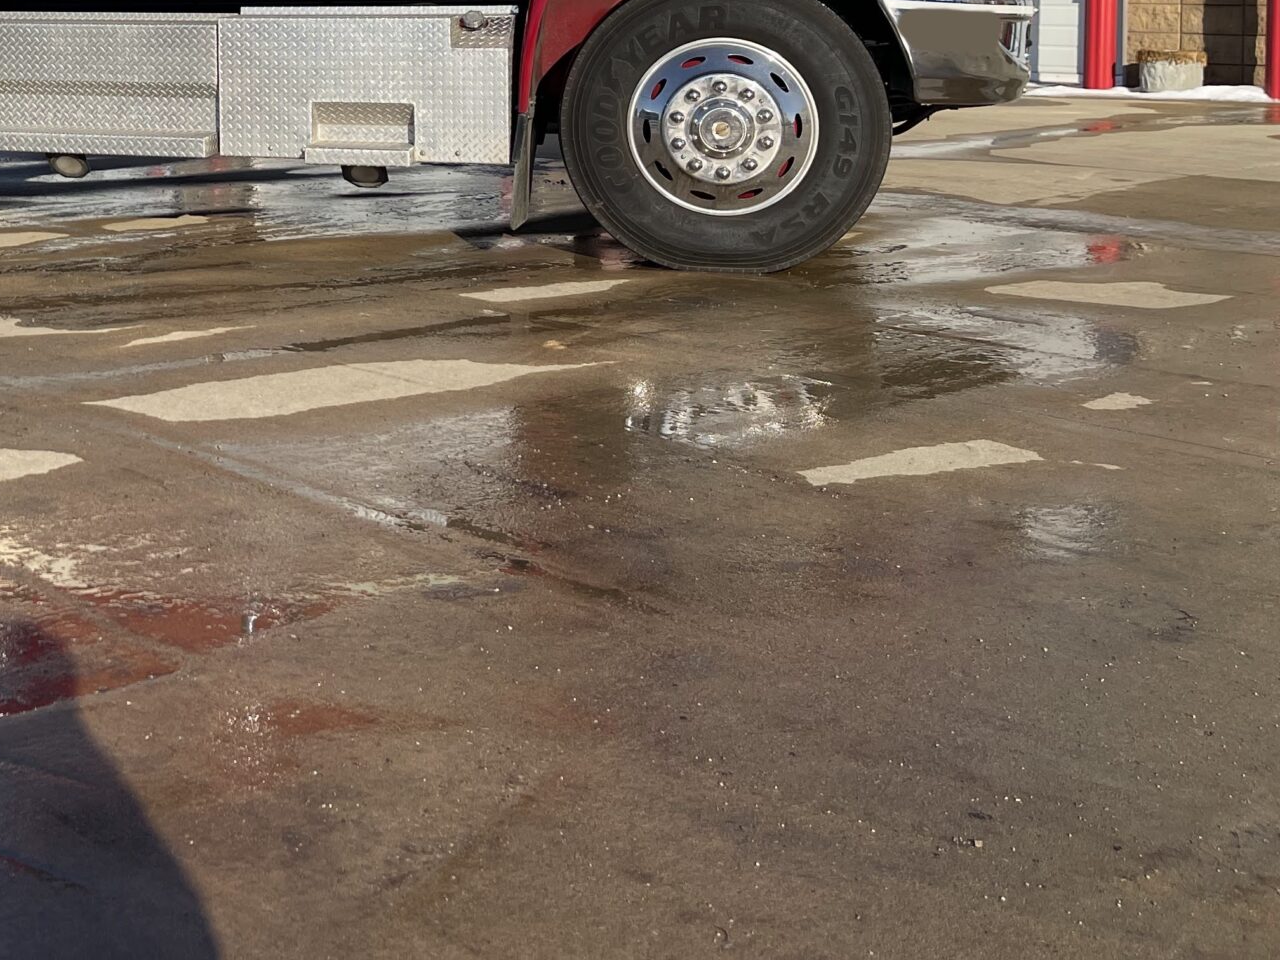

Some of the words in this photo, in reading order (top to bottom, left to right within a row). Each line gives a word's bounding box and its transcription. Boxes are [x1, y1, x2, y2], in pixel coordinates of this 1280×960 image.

[589, 5, 728, 194] GOODYEAR
[832, 85, 857, 178] G149
[750, 191, 832, 245] RSA
